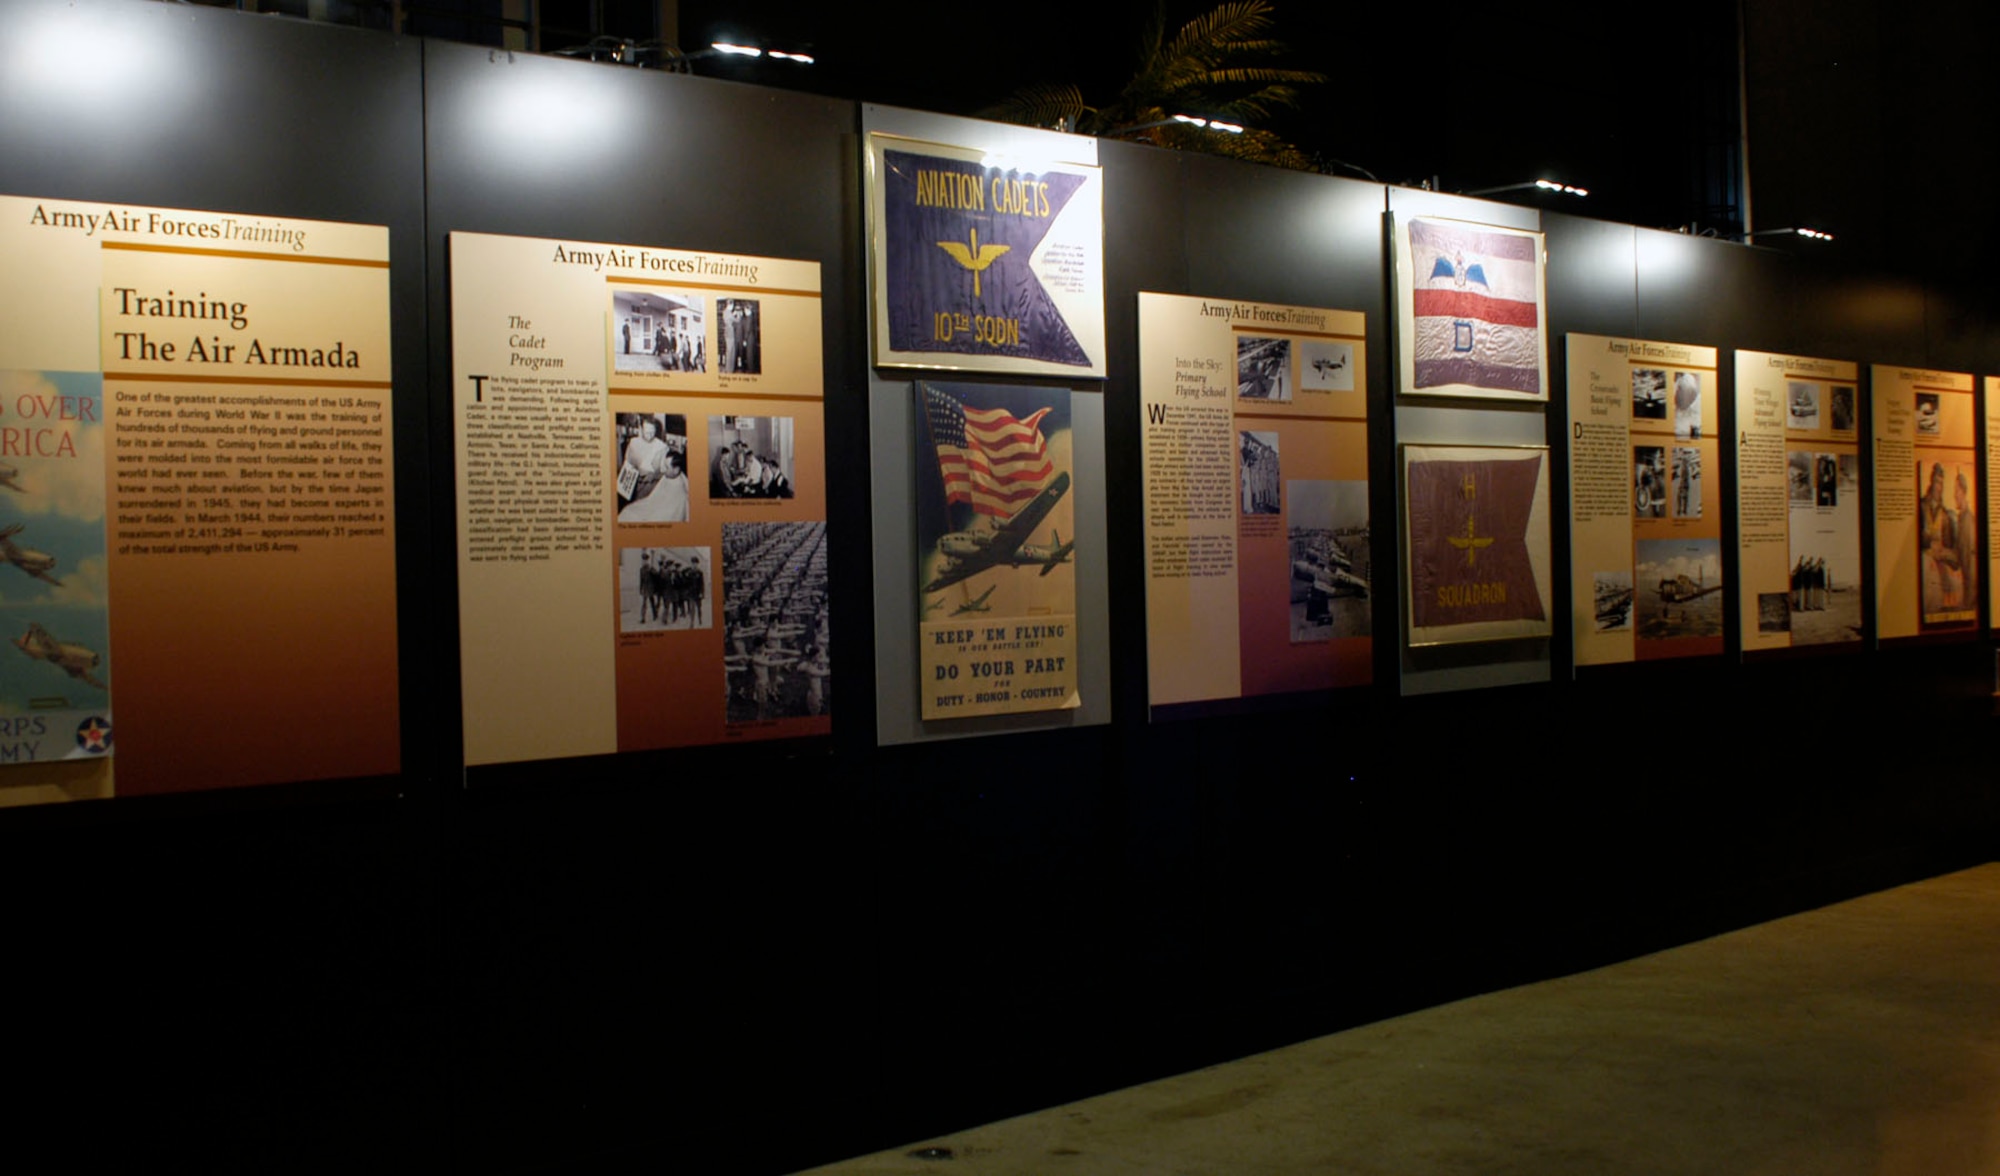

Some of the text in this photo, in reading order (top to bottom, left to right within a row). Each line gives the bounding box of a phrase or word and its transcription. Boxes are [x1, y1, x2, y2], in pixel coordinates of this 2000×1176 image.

[916, 170, 1050, 218] AVIATION CADETS
[114, 288, 248, 330] Training
[507, 314, 532, 331] The
[974, 315, 1018, 346] SQDN
[508, 334, 546, 350] Cadet
[1454, 322, 1472, 352] D
[115, 333, 360, 368] The Air Armada
[510, 352, 564, 372] Program
[1175, 357, 1223, 371] Into the Sky:
[1175, 372, 1207, 385] Primary
[1175, 384, 1227, 399] Flying School
[16, 394, 96, 422] OVER
[115, 391, 137, 401] One
[154, 392, 170, 402] the
[173, 393, 216, 406] greatest
[219, 394, 306, 408] accomplishments
[321, 397, 336, 407] the
[356, 398, 381, 410] Army
[117, 406, 130, 416] Air
[137, 407, 171, 417] Forces
[178, 408, 209, 420] during
[216, 409, 244, 419] World
[250, 410, 268, 419] War
[287, 412, 305, 420] was
[311, 411, 325, 421] the
[332, 412, 367, 424] training
[116, 421, 165, 432] hundreds
[181, 423, 234, 433] thousands
[249, 424, 277, 436] flying
[279, 425, 297, 434] and
[300, 425, 334, 437] ground
[335, 426, 382, 438] personnel
[115, 437, 132, 447] for
[133, 437, 149, 447] its
[149, 437, 164, 447] air
[166, 437, 208, 447] armada.
[215, 438, 257, 450] Coming
[258, 439, 283, 448] from
[283, 439, 297, 449] all
[298, 439, 327, 449] walks
[340, 440, 358, 450] life,
[361, 440, 382, 452] they
[116, 452, 384, 464] were molded into the most formidable air force the
[116, 467, 149, 477] world
[150, 467, 173, 477] had
[174, 469, 199, 477] ever
[238, 468, 274, 477] Before
[276, 468, 295, 477] the
[296, 470, 319, 478] war,
[321, 468, 342, 477] few
[357, 468, 384, 477] them
[115, 482, 147, 492] knew
[151, 482, 183, 492] much
[185, 482, 218, 492] about
[219, 482, 264, 493] aviation,
[268, 482, 288, 492] but
[306, 482, 325, 492] the
[327, 482, 351, 492] time
[353, 482, 385, 494] Japan
[1464, 472, 1476, 501] H
[117, 497, 182, 507] surrendered
[203, 497, 233, 507] 1945,
[239, 497, 261, 509] they
[266, 497, 286, 506] had
[290, 497, 329, 506] become
[334, 496, 370, 508] experts
[1437, 582, 1508, 607] SQUADRON
[981, 628, 1006, 641] 'EM
[972, 644, 987, 652] OUR
[992, 642, 1020, 650] BATTLE
[936, 657, 1065, 680] DO YOUR PART
[994, 680, 1011, 688] FOR
[937, 686, 1065, 707] DUTY HONOR COUNTRY
